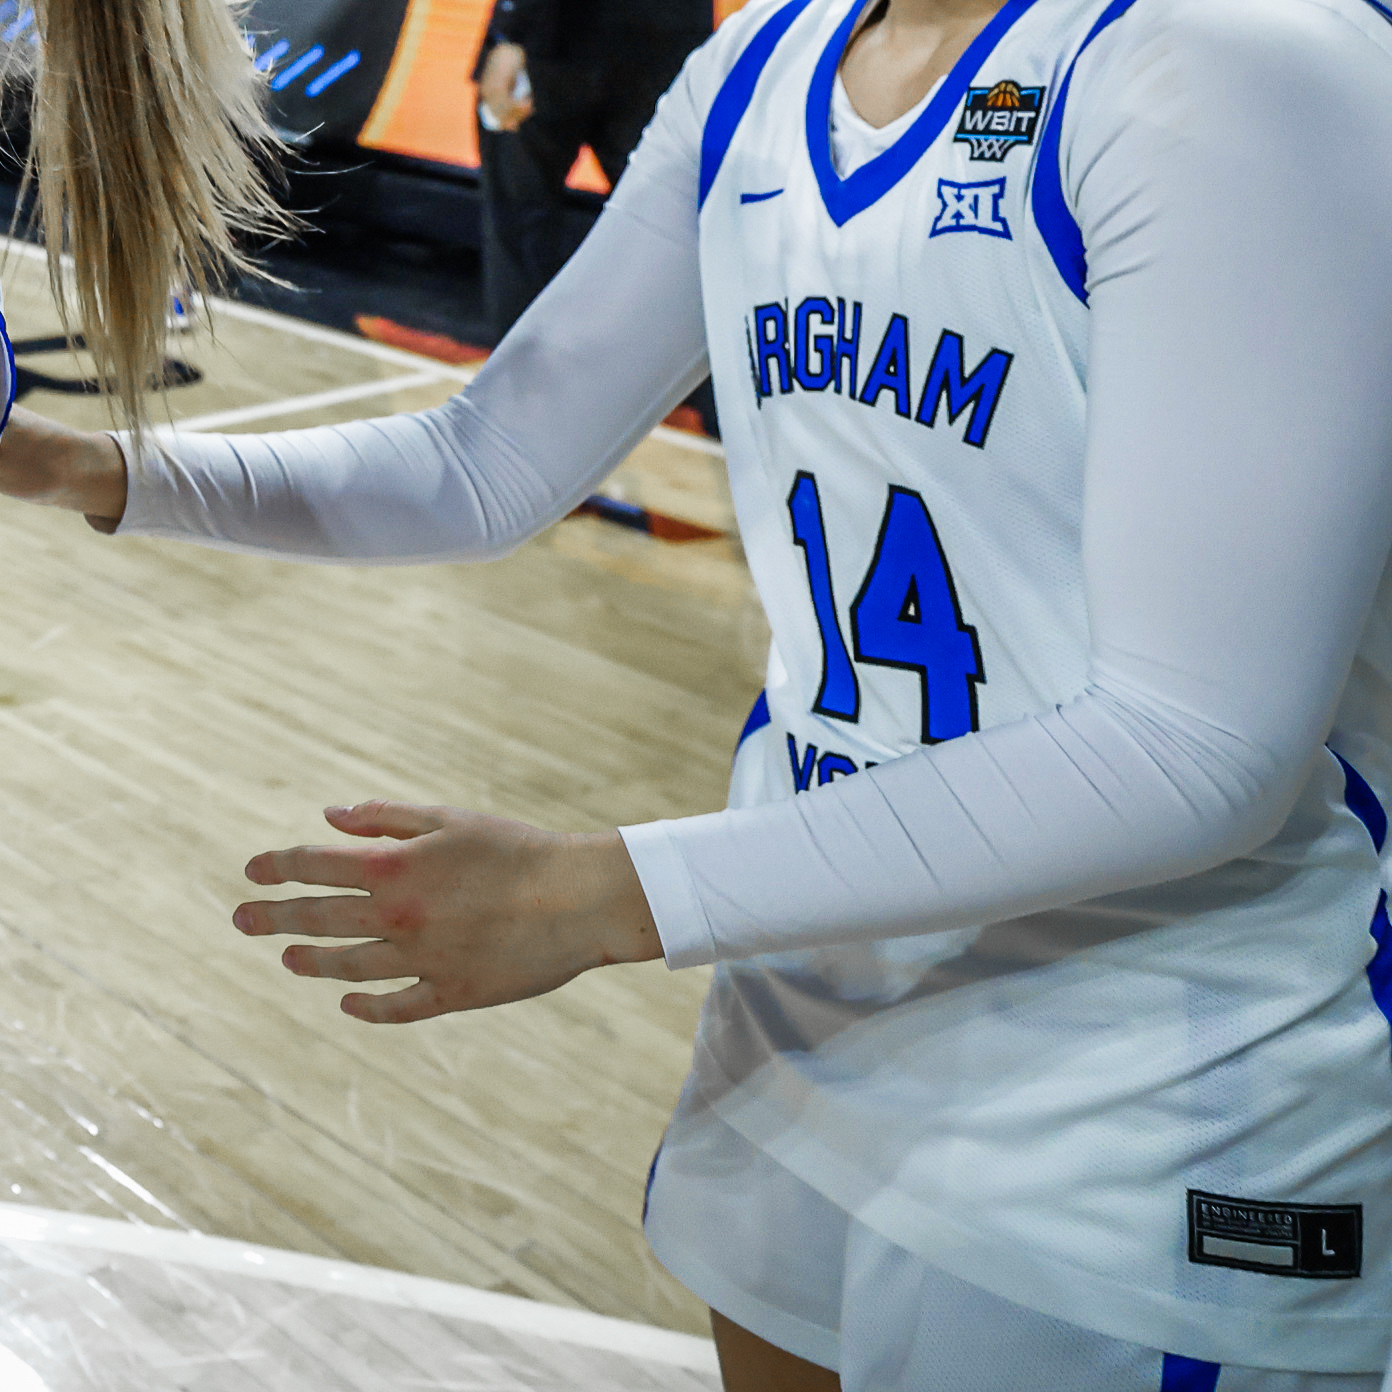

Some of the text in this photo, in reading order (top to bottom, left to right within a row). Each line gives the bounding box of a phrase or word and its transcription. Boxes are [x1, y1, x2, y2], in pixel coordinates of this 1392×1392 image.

[963, 110, 1036, 133] WBIT
[787, 469, 987, 746] 14
[1320, 1227, 1337, 1257] L
